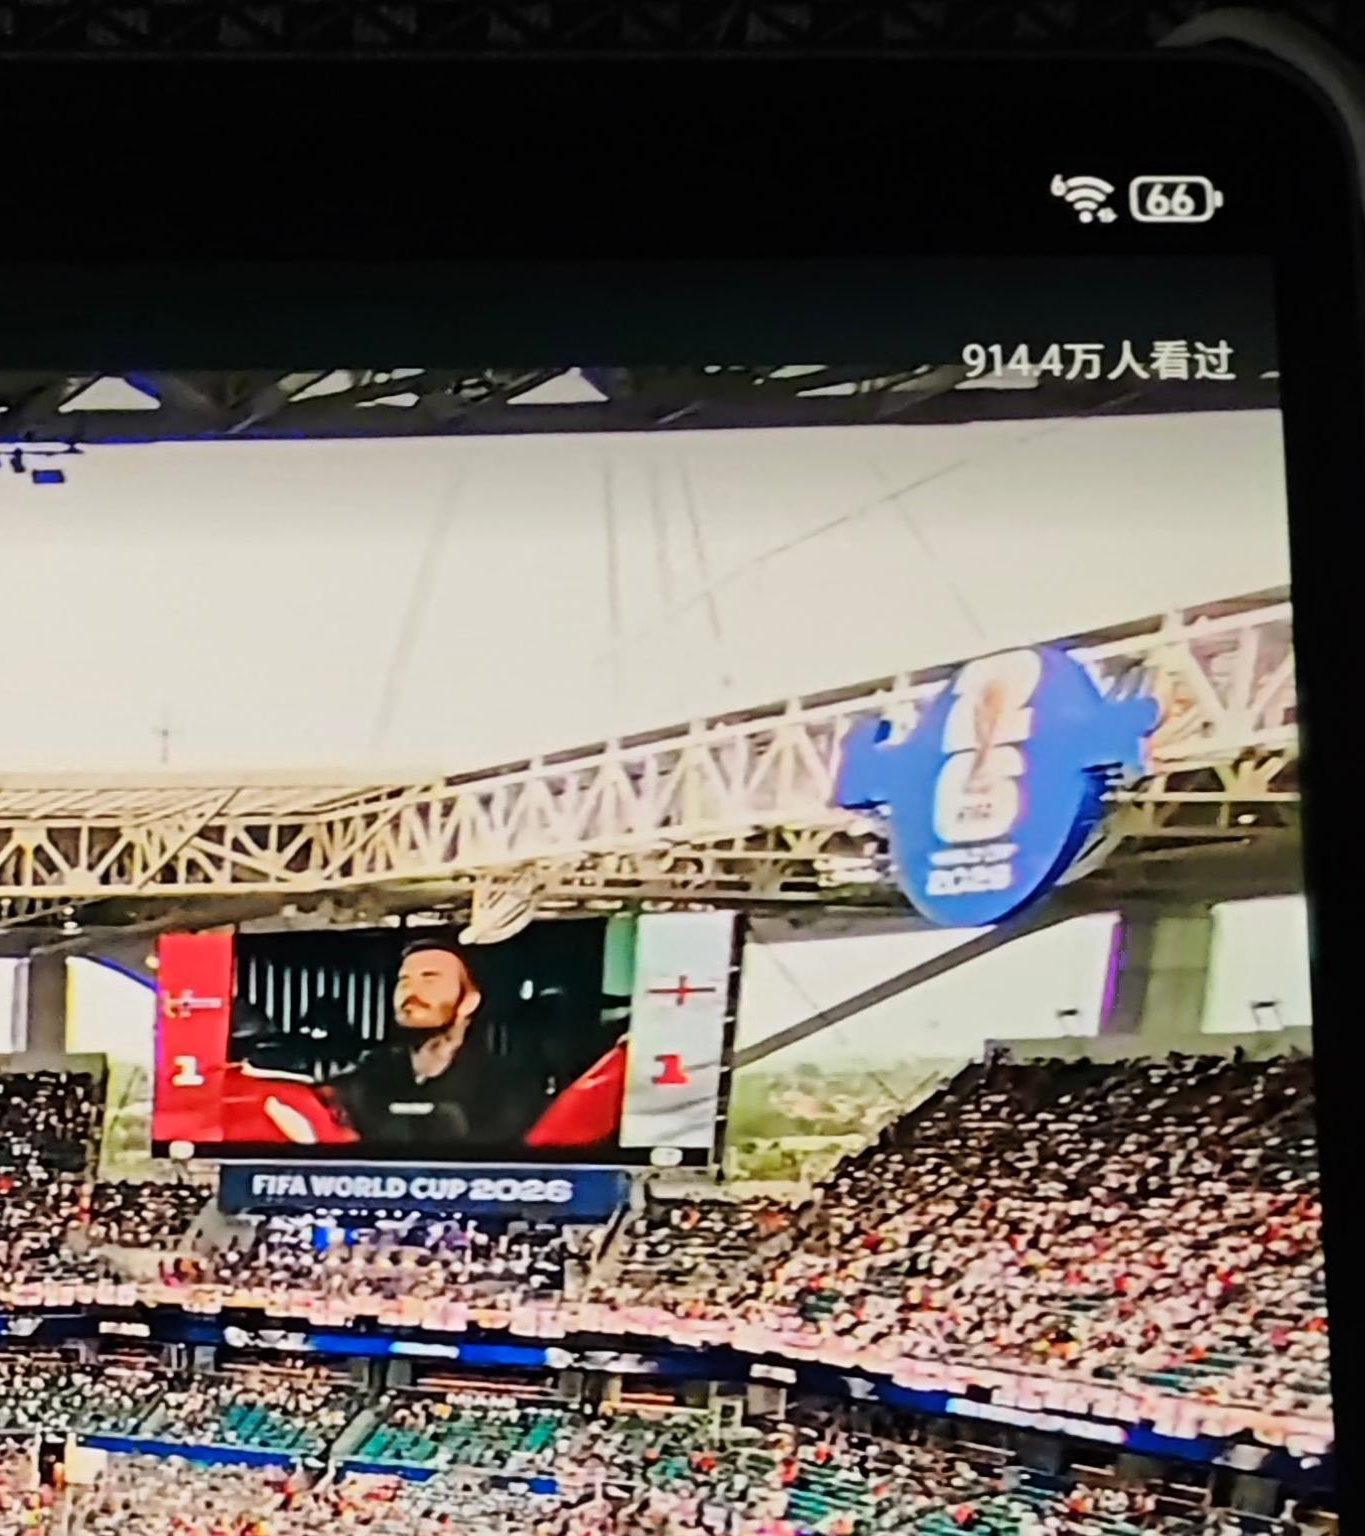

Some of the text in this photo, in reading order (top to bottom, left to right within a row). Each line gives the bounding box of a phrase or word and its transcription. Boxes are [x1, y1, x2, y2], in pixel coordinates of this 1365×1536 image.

[1146, 183, 1195, 216] 66
[962, 339, 1236, 381] 914.4万人看过
[171, 1055, 205, 1087] 1
[252, 1174, 574, 1203] FIFA WORLD CUP 2026
